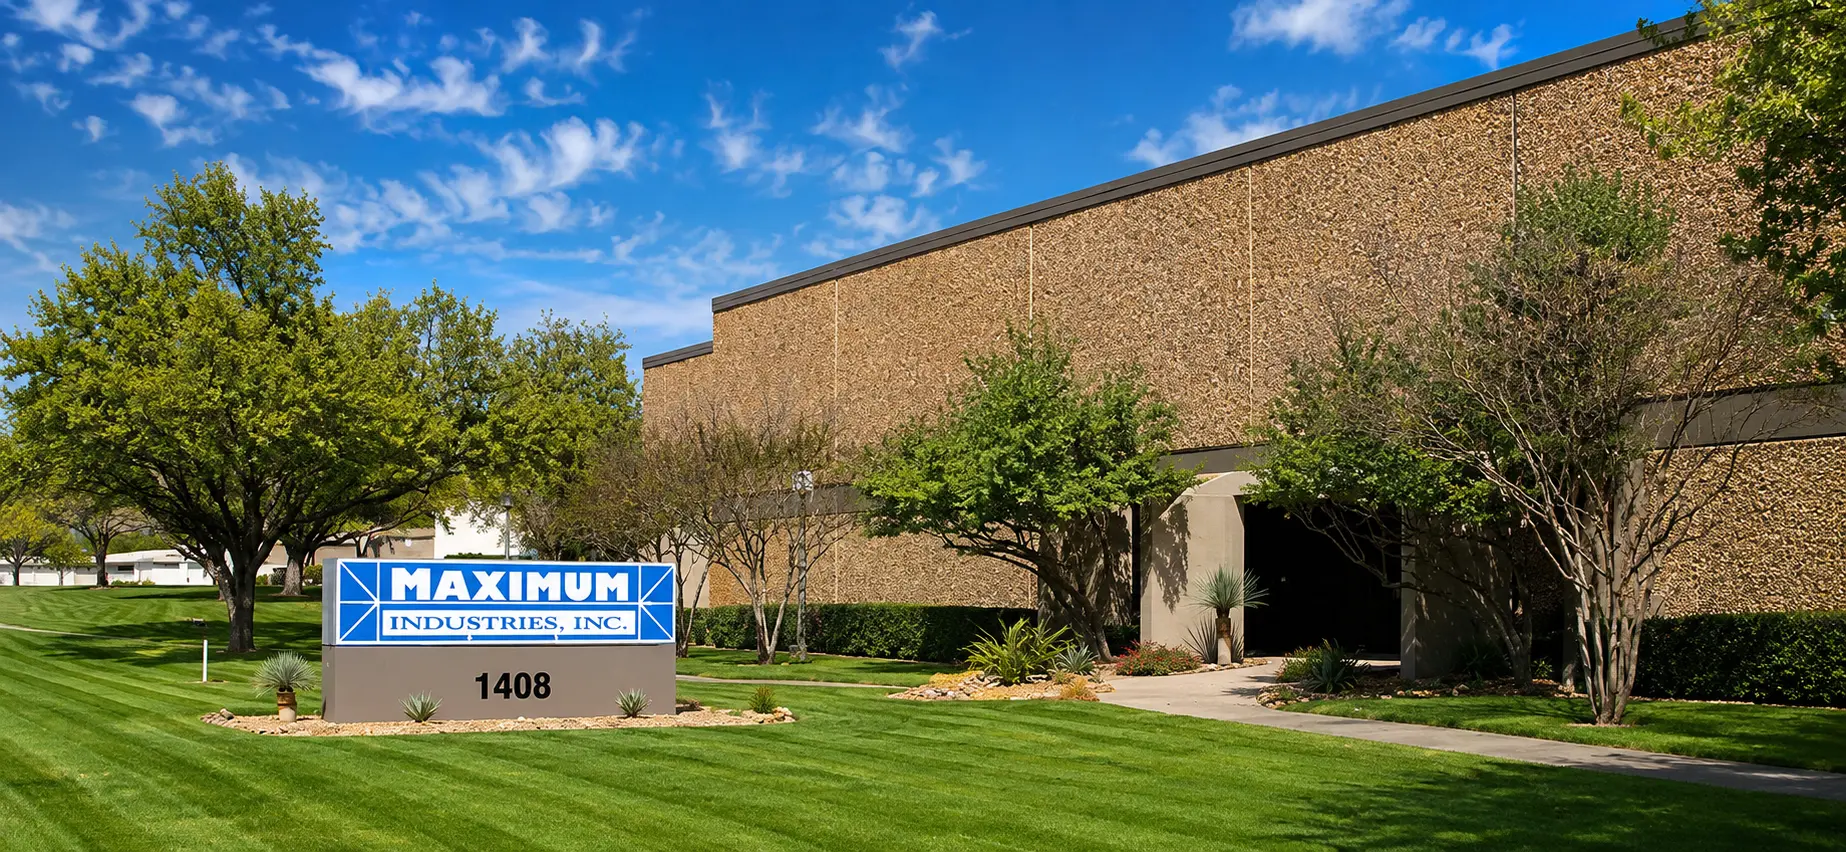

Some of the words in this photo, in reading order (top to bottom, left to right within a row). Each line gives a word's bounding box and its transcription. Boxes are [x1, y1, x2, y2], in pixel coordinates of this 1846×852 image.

[391, 567, 629, 602] MAXIMUM
[390, 615, 565, 633] INDUSTRIES,
[574, 615, 628, 631] INC.
[475, 671, 551, 700] 1408
